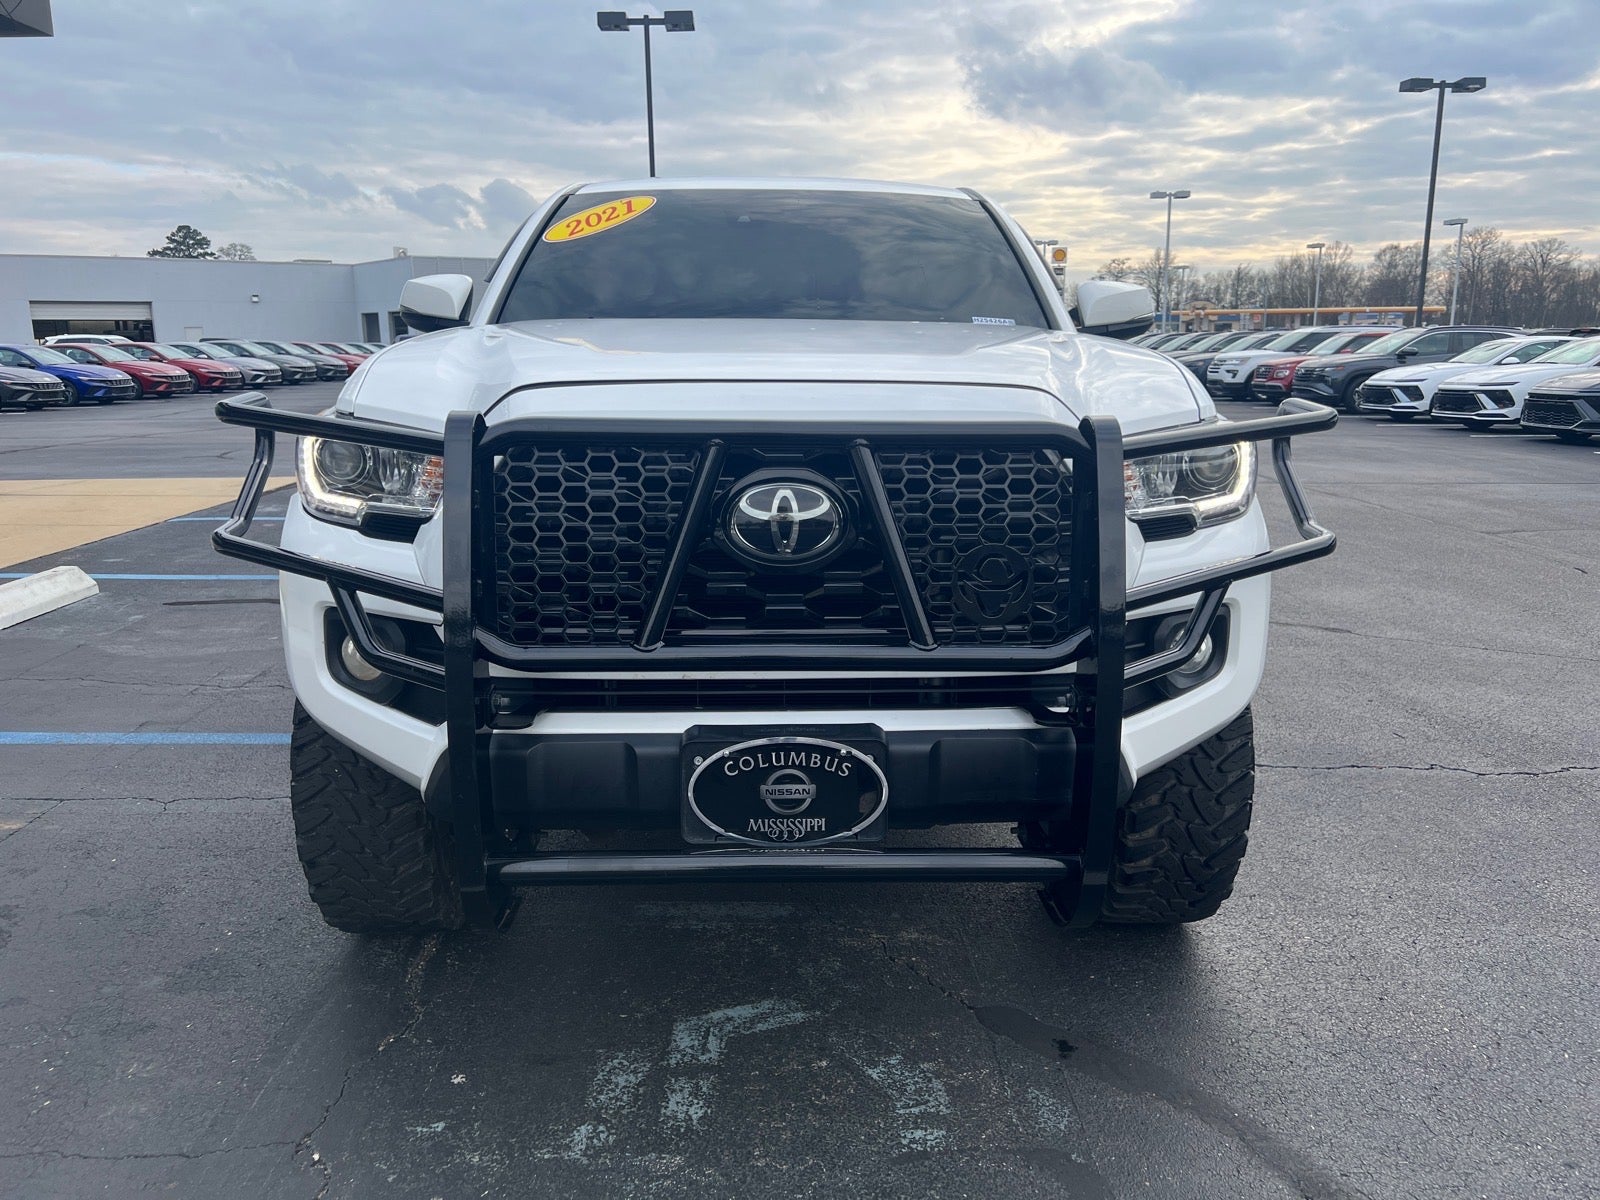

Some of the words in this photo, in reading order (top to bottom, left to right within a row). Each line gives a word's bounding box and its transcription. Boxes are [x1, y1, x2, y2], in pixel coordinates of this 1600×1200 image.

[565, 199, 637, 238] 2021
[724, 751, 852, 777] COLUMBUS
[765, 787, 811, 796] NISSAN
[747, 818, 826, 841] MISSISSIPPI
